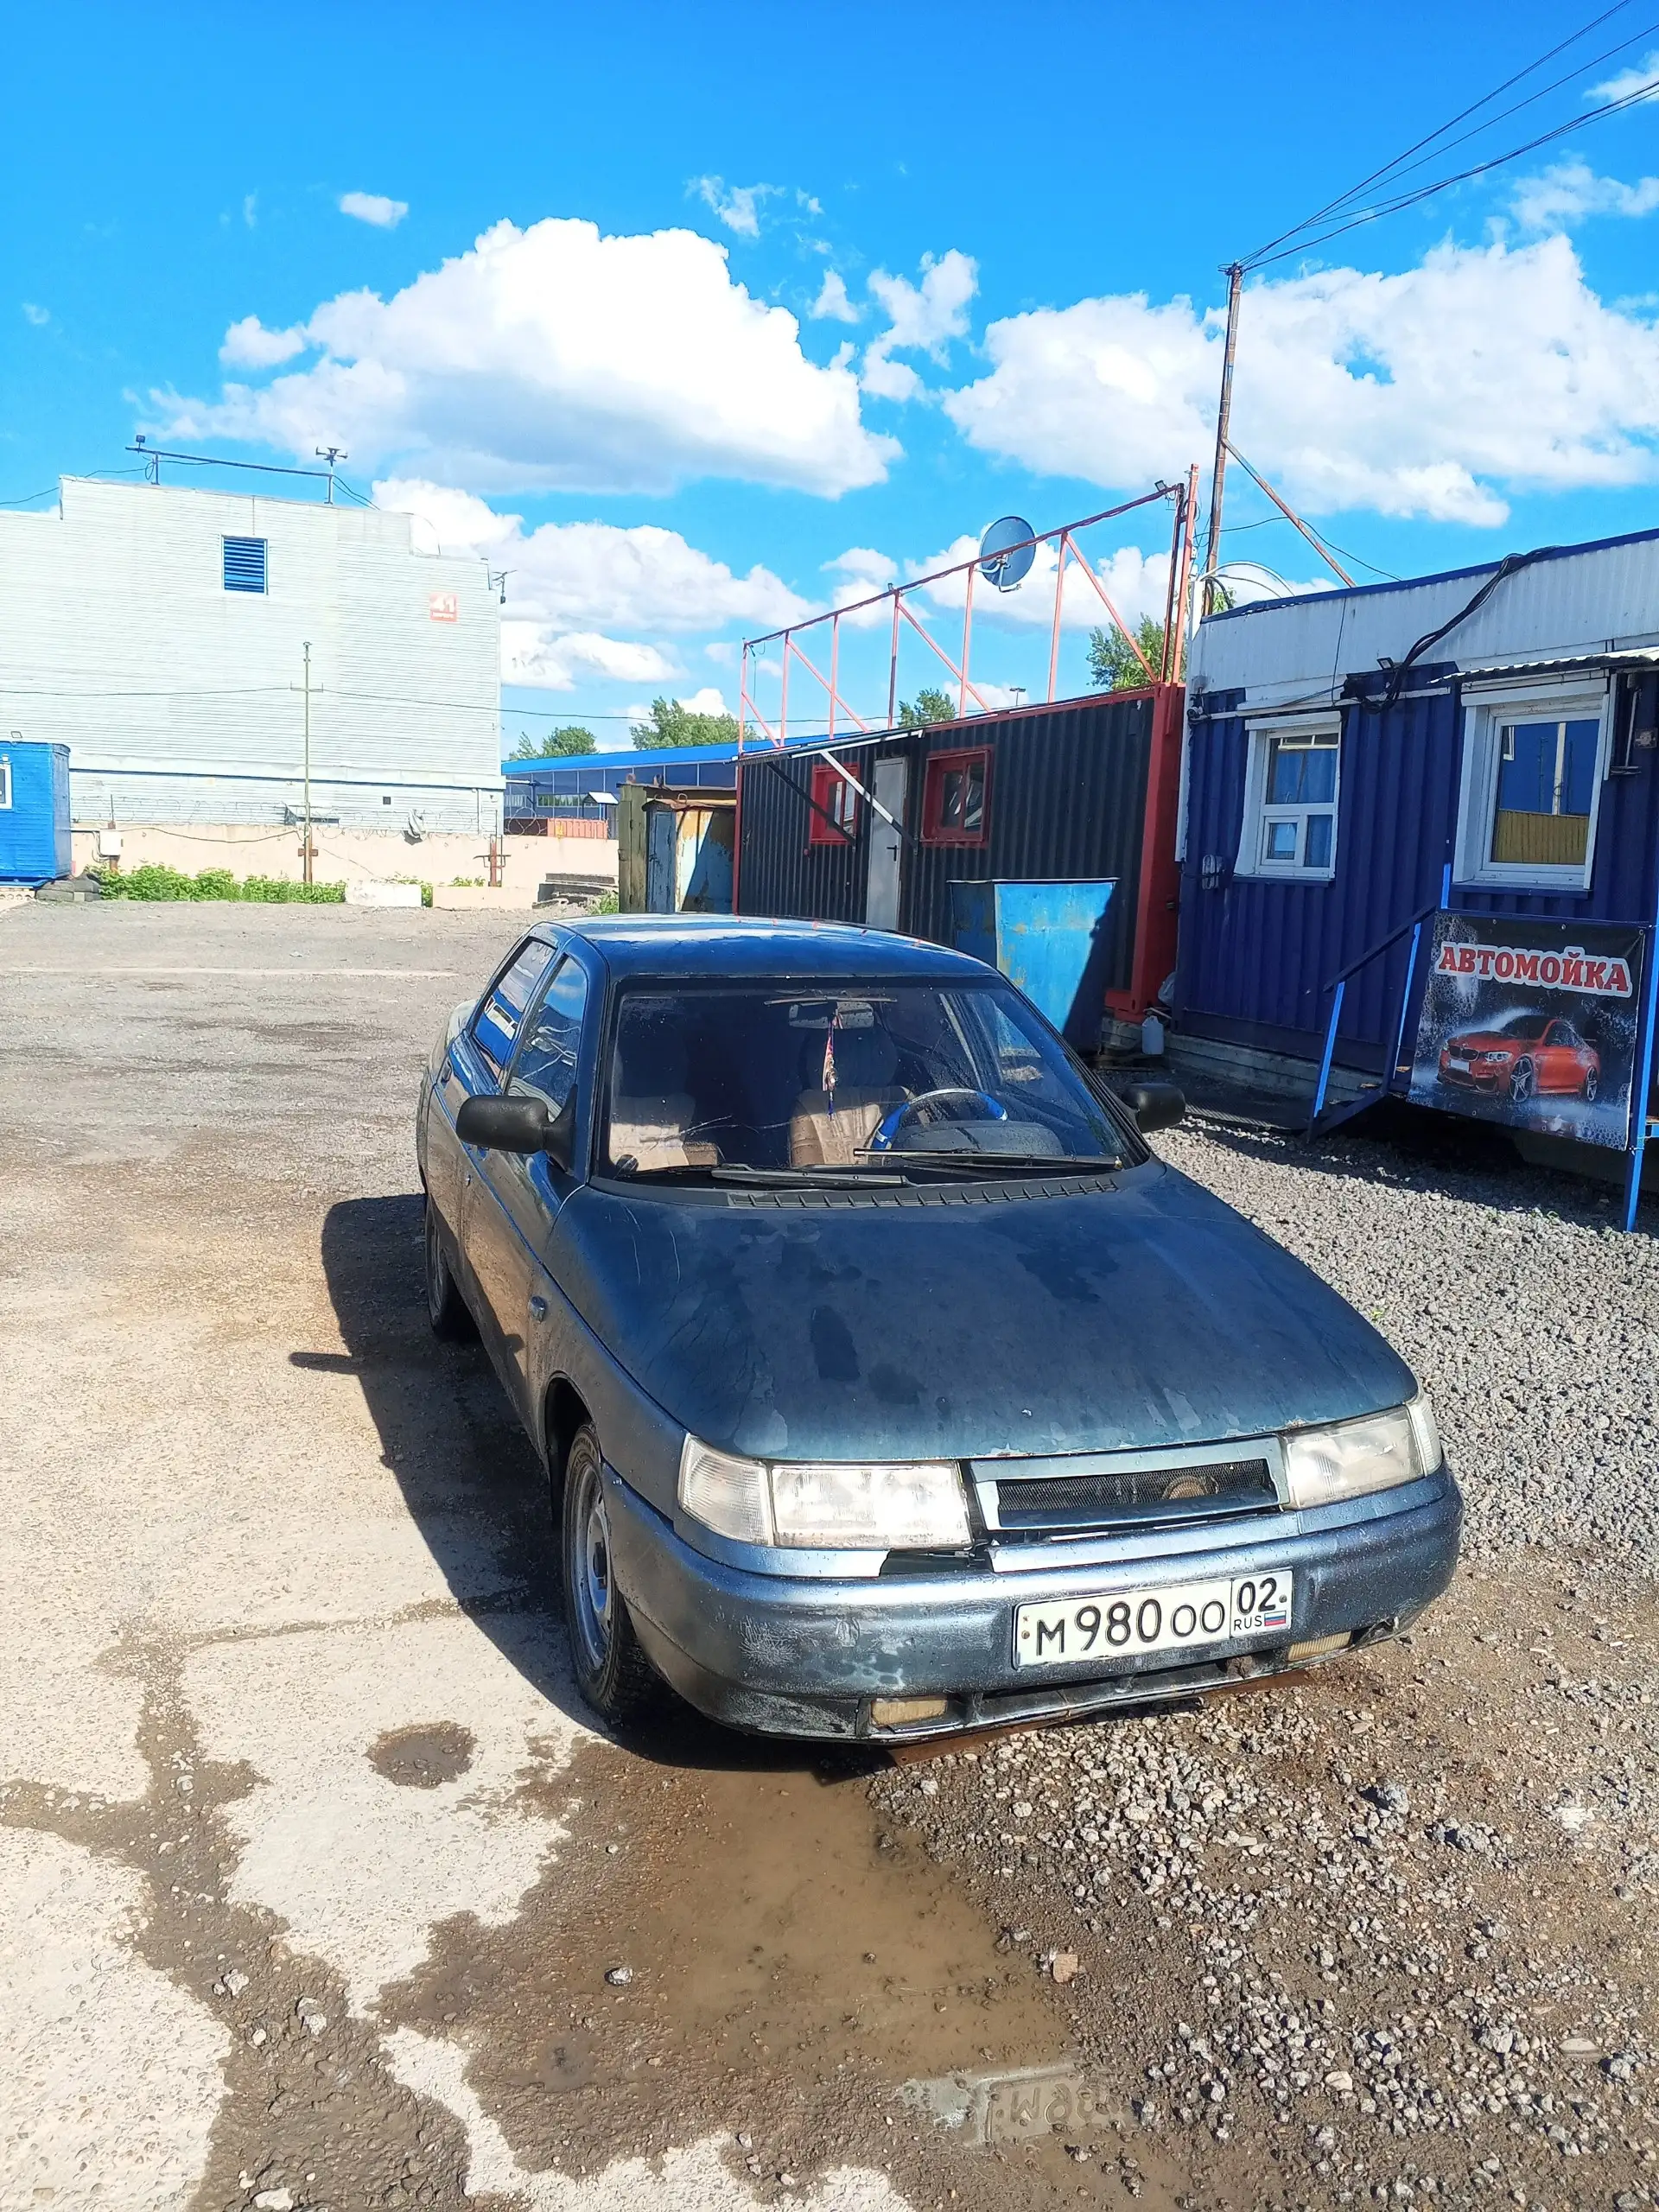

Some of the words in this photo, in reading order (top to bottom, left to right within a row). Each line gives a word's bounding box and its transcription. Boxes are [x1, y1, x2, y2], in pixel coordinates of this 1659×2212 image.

[431, 593, 455, 613] 41
[1438, 946, 1629, 992] АВТОМОЙКА
[1236, 1577, 1278, 1615] 02
[1233, 1615, 1263, 1631] RUS
